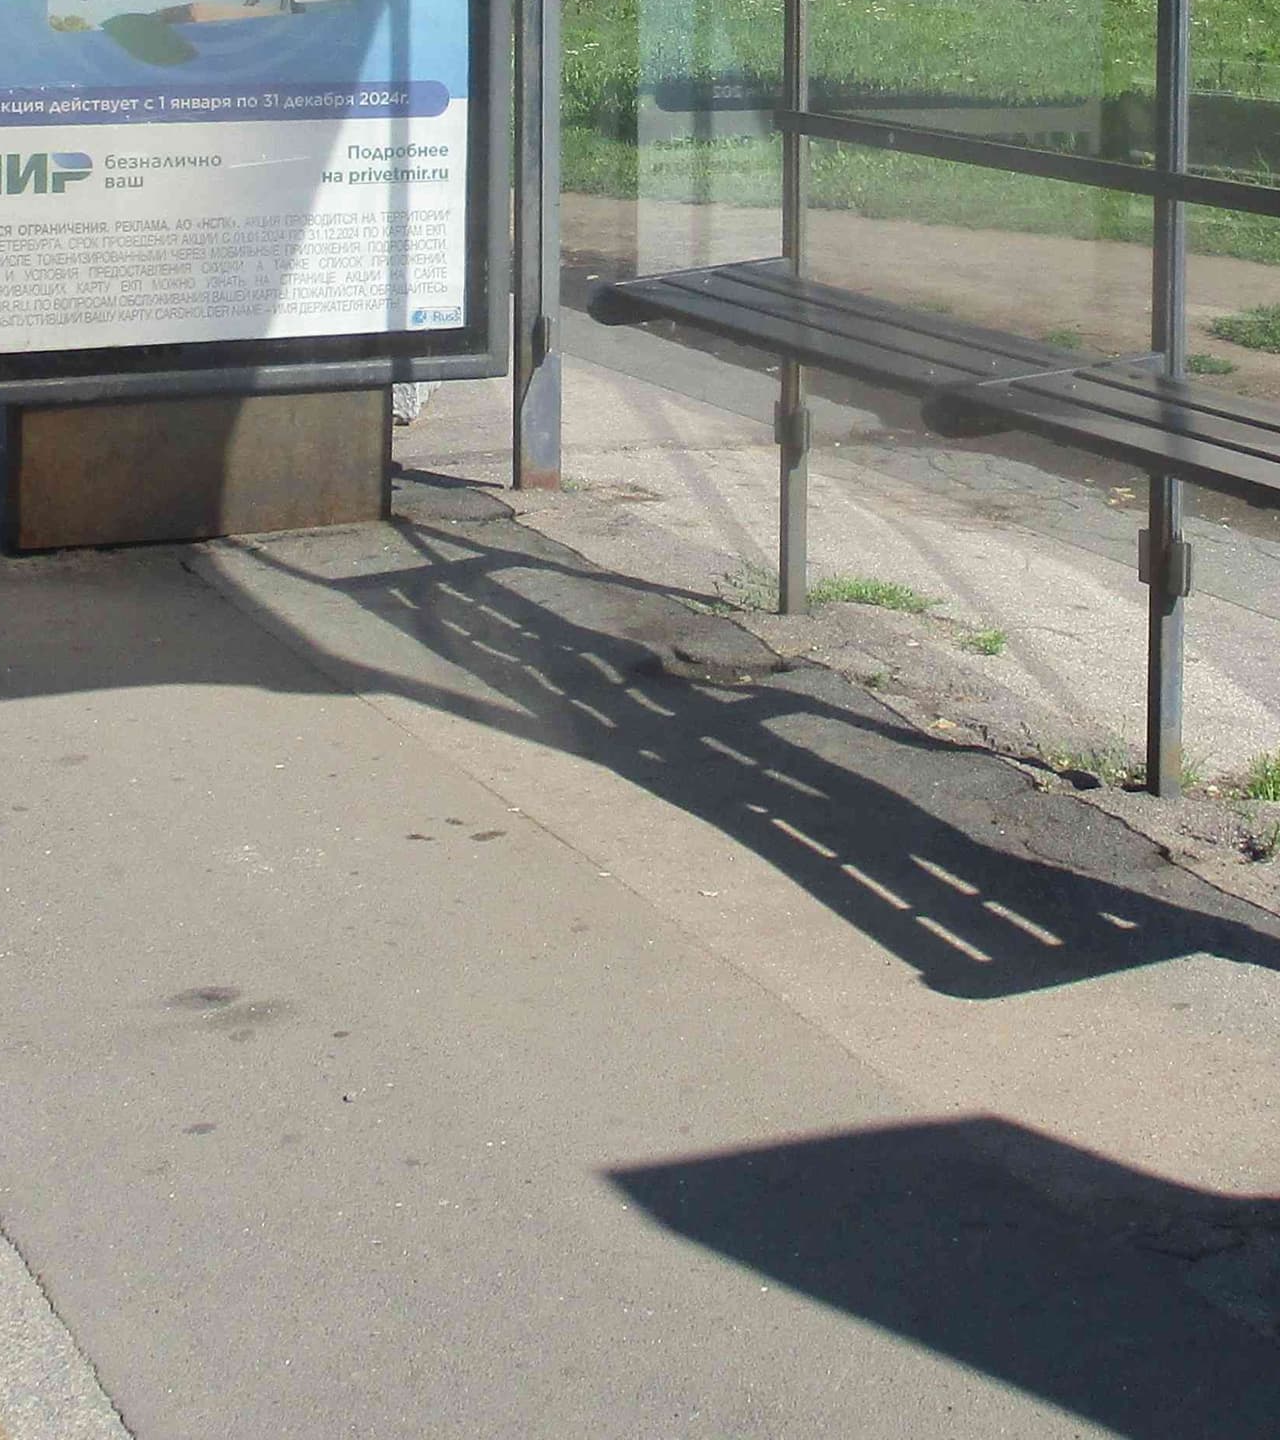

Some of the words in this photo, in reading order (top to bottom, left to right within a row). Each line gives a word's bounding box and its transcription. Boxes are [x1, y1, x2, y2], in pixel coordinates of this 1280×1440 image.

[49, 95, 139, 113] действует
[144, 98, 155, 110] с
[159, 95, 165, 109] 1
[171, 95, 232, 111] января
[237, 96, 259, 109] по
[264, 93, 280, 108] 31
[283, 91, 355, 109] декабря
[359, 91, 410, 107] 2024г.
[105, 152, 223, 170] безналично
[348, 144, 449, 162] Подробнее
[105, 174, 144, 189] ваш
[322, 169, 343, 183] на
[349, 165, 449, 185] privetmir.ru
[285, 213, 357, 226] ПРОВОДИТСЯ
[362, 213, 375, 223] НА
[381, 210, 450, 222] ТЕРРИТОРИИ
[103, 235, 177, 249] ПРОВЕДЕНИЯ
[309, 228, 359, 240] 31.12.2024
[363, 227, 378, 238] ПО
[25, 269, 79, 282] УСЛОВИЯ
[89, 264, 192, 278] ПРЕДОСТАВЛЕНИЯ
[77, 281, 110, 294] КАРТУ
[414, 267, 448, 280] САЙТЕ
